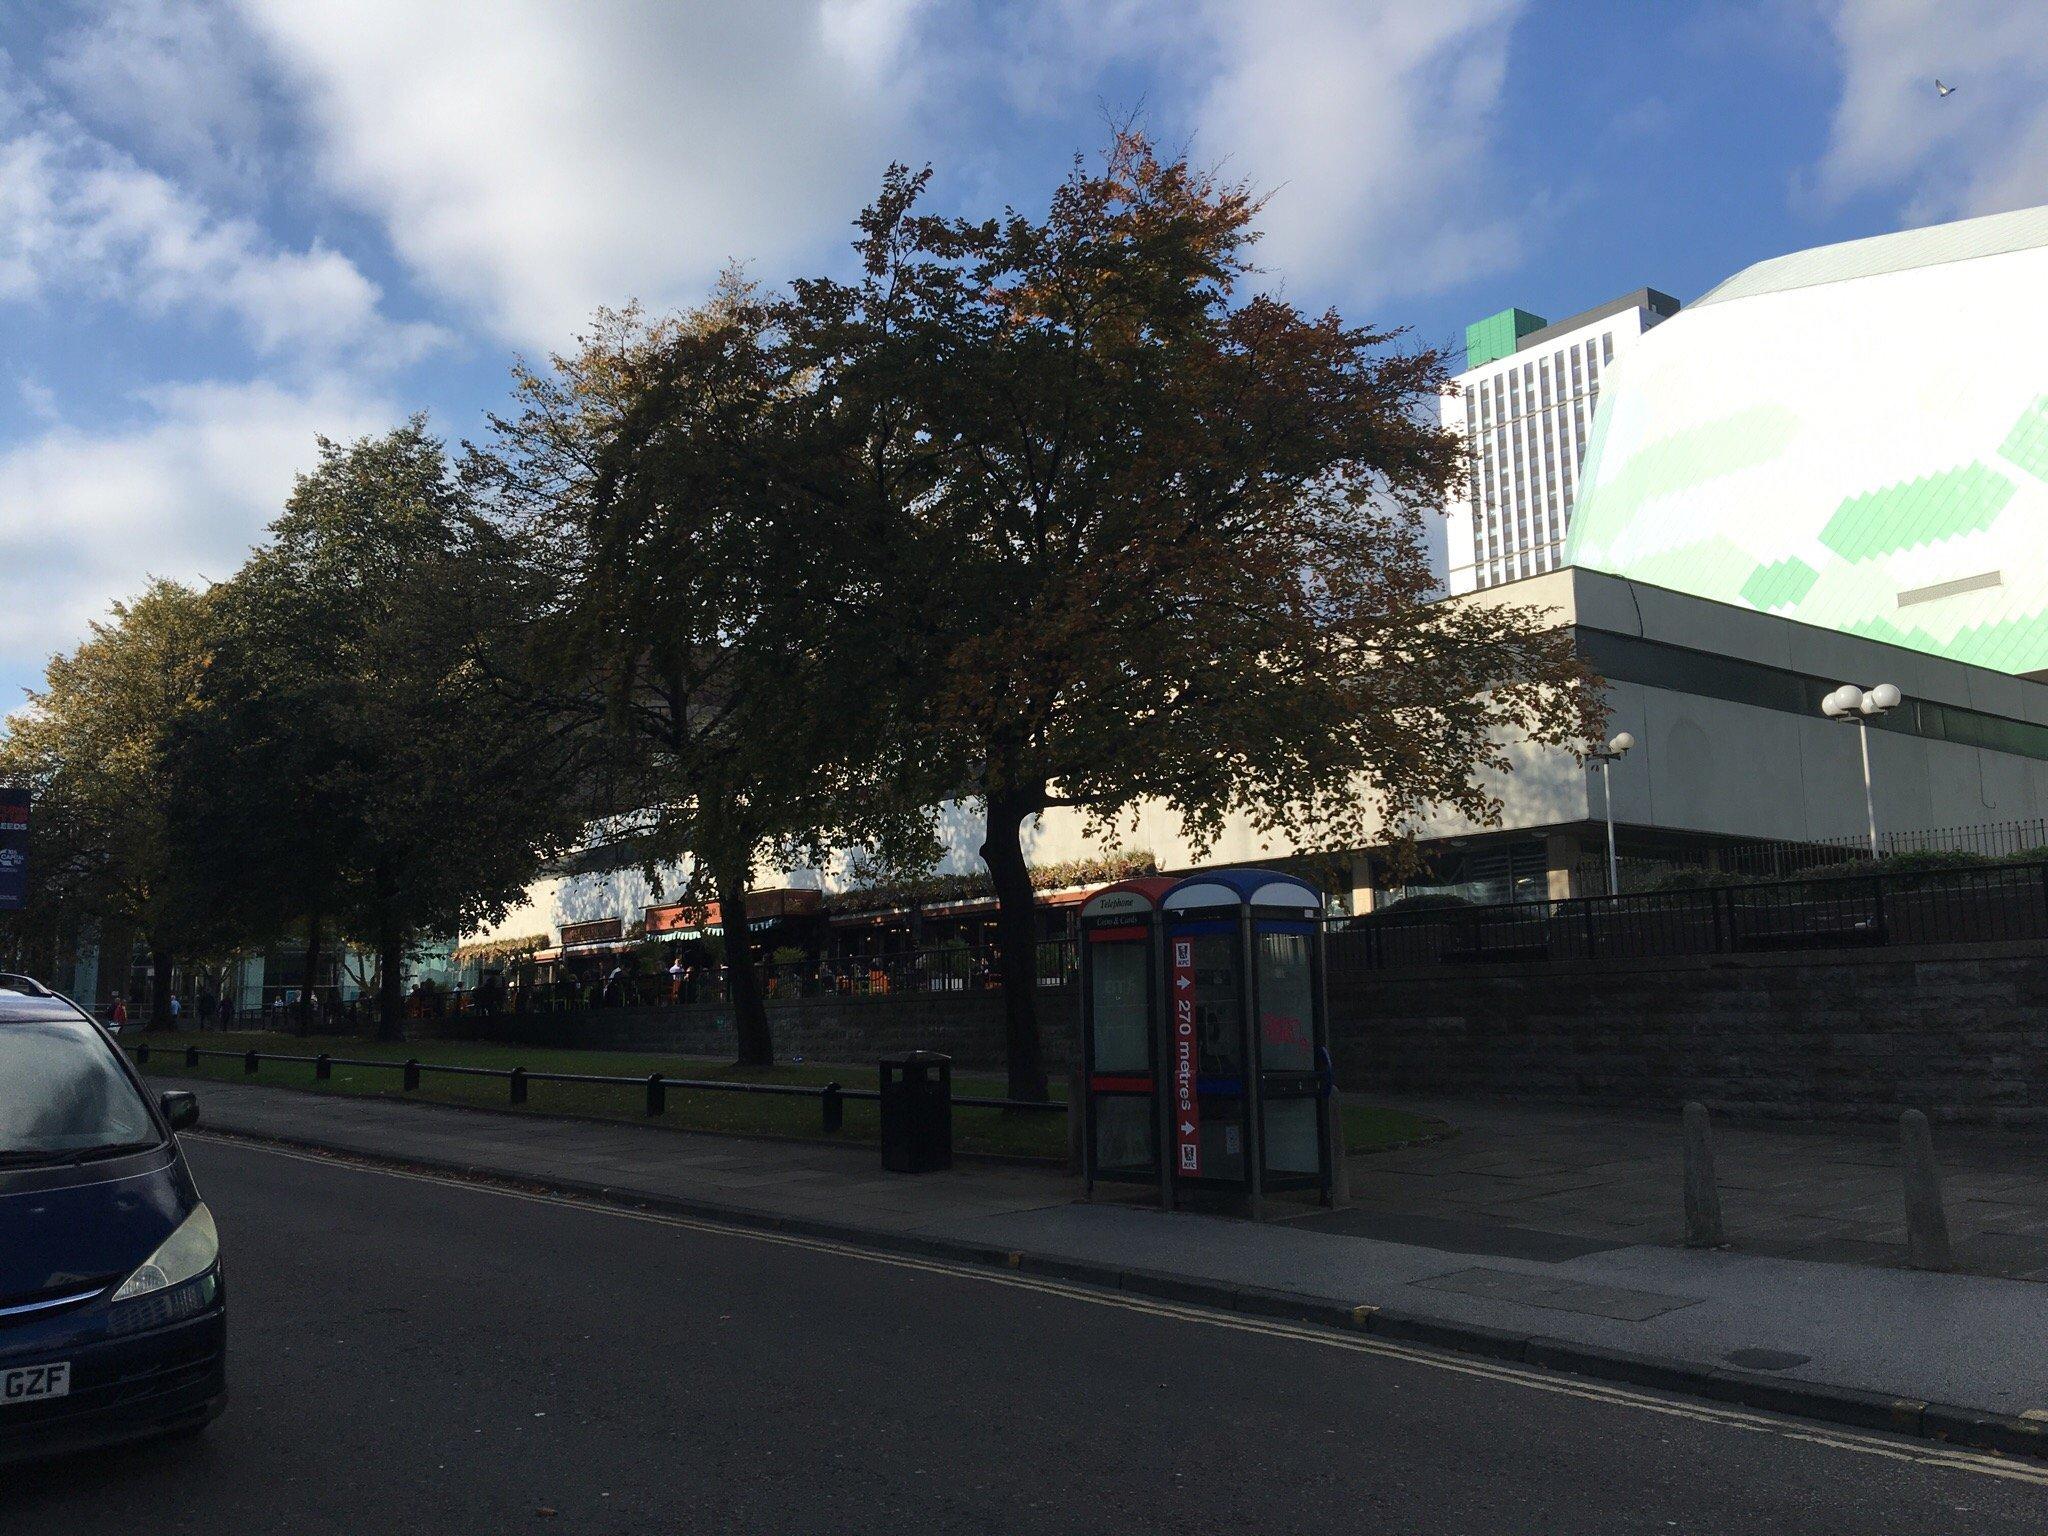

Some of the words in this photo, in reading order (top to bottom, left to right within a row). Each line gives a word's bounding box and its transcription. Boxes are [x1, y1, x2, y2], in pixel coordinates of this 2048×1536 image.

[0, 823, 27, 831] EEDS
[1100, 898, 1134, 909] Telephone
[1178, 1000, 1192, 1035] 270
[1179, 1042, 1191, 1111] metres
[6, 1366, 65, 1397] GZF
